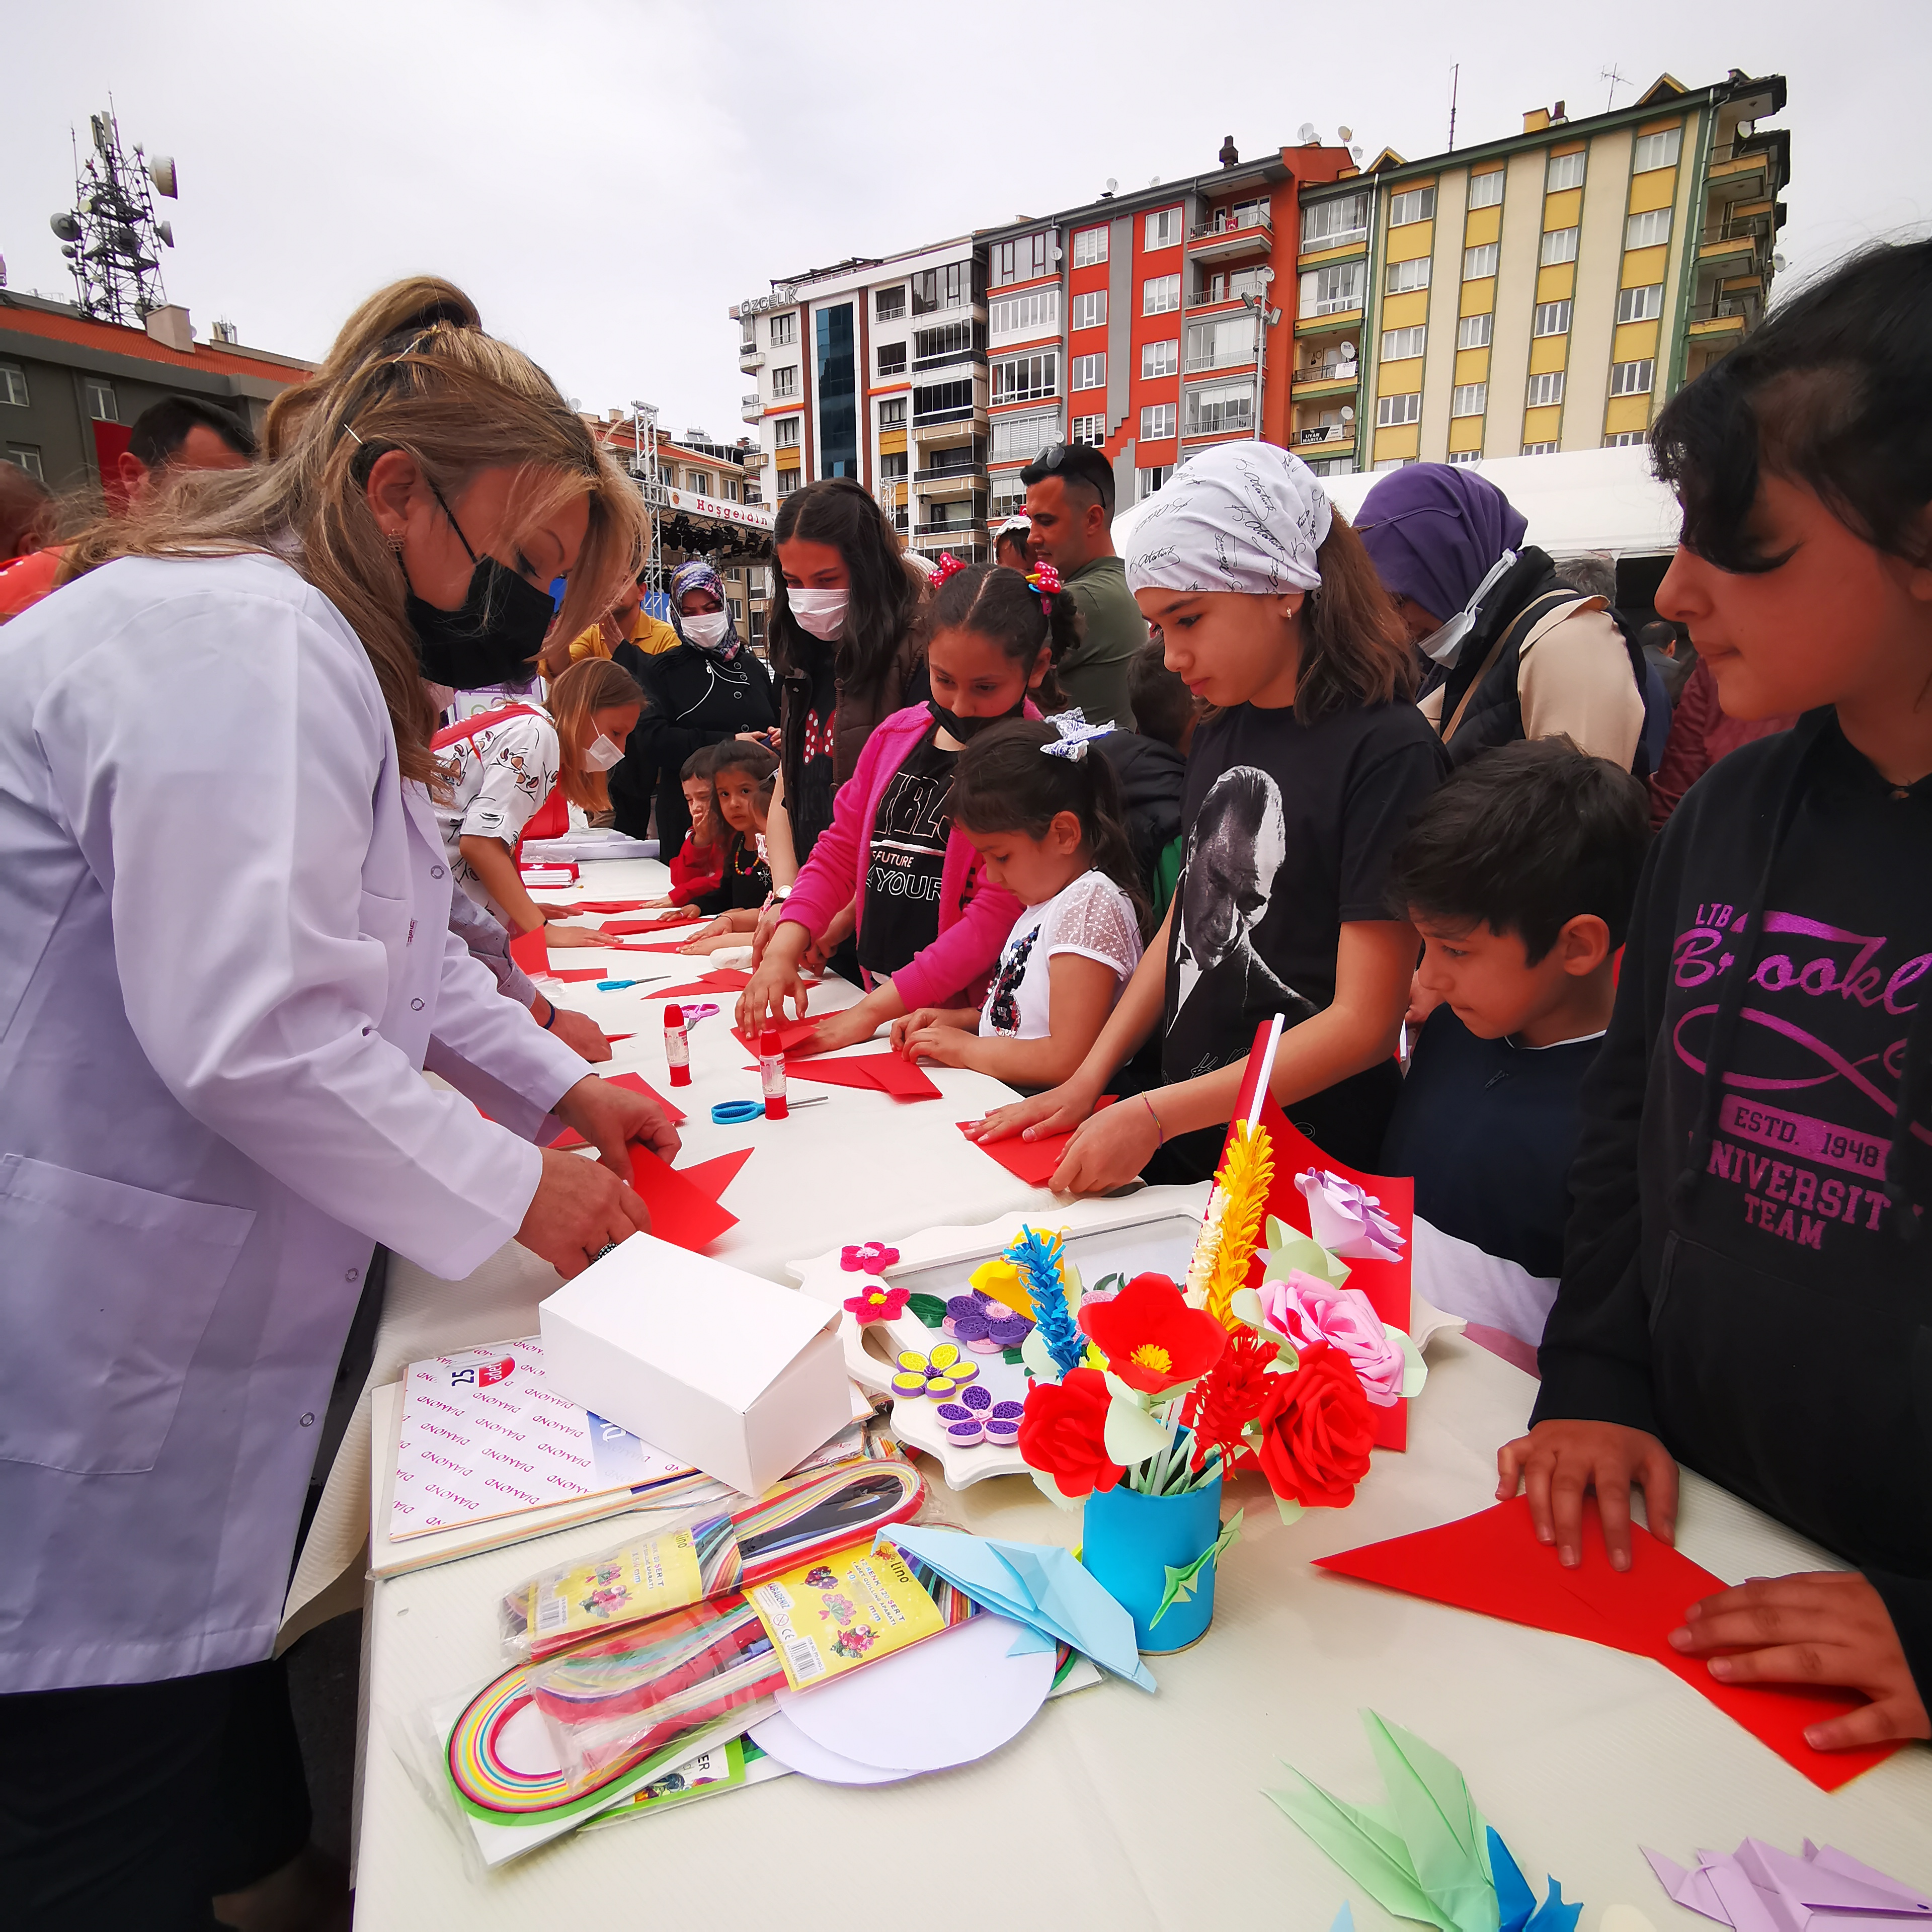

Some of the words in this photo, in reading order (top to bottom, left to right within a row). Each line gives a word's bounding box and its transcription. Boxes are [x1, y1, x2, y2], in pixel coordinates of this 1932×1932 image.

[1695, 903, 1733, 927] LTB
[1734, 1106, 1800, 1146] ESTD.
[1821, 1133, 1879, 1167] 1948
[1698, 1135, 1907, 1231] NIVERSIT
[1744, 1193, 1827, 1250] TEAM
[451, 1369, 474, 1387] 25
[484, 1363, 502, 1381] adet
[417, 1396, 465, 1416] DIAMOND
[472, 1392, 521, 1413] DIAMOND
[525, 1388, 575, 1409] DIAMOND
[421, 1423, 471, 1445] DIAMOND
[475, 1418, 526, 1441] DIAMOND
[533, 1415, 584, 1438] DIAMOND
[421, 1451, 473, 1476] DIAMOND
[481, 1448, 534, 1473] DIAMOND
[538, 1443, 592, 1468] DIAMOND
[425, 1484, 479, 1510] DIAMOND
[485, 1478, 540, 1505] DIAMOND
[860, 1558, 868, 1566] 12
[865, 1567, 881, 1586] RENK
[879, 1587, 890, 1599] 120
[891, 1561, 909, 1583] lino
[854, 1564, 865, 1577] ADET
[863, 1578, 881, 1602] QUILLING
[879, 1602, 896, 1625] APARATI
[868, 1605, 881, 1621] mm
